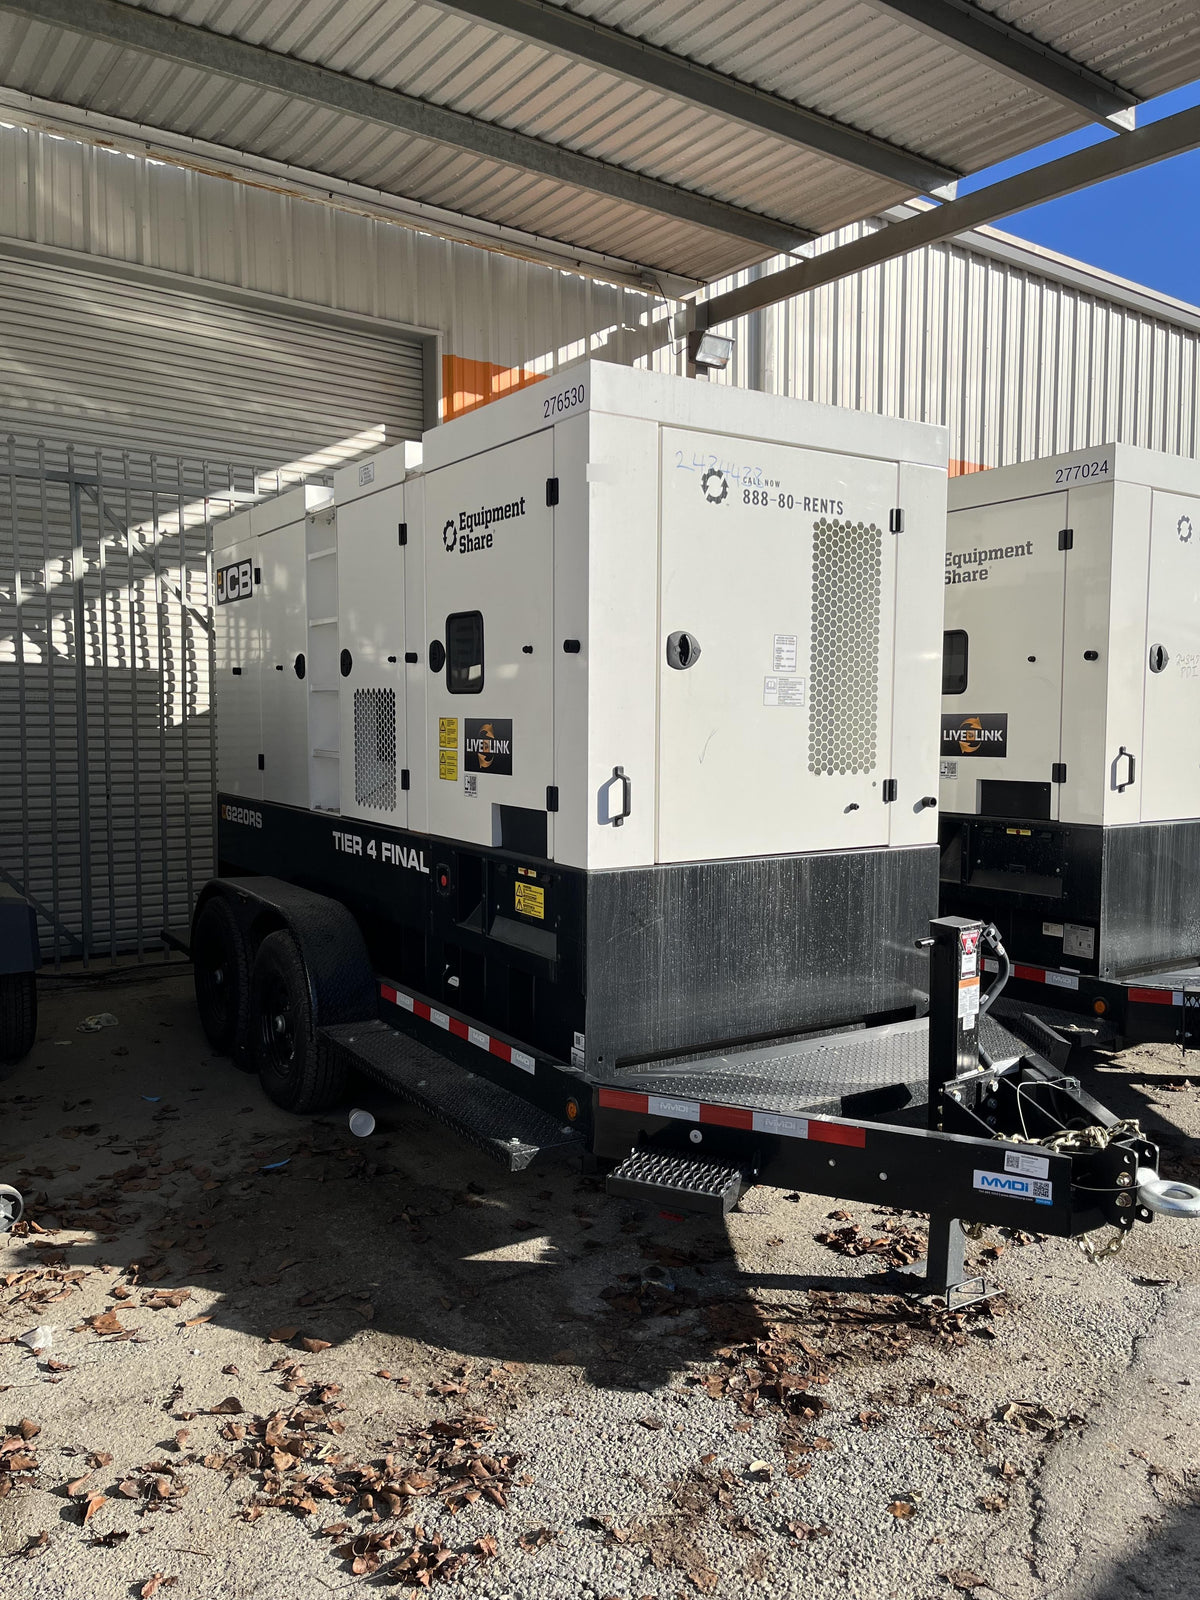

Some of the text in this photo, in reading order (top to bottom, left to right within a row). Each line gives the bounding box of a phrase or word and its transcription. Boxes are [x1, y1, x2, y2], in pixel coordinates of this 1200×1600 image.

[543, 384, 585, 418] 276530
[743, 476, 781, 488] CALL NOW
[1055, 459, 1109, 484] 277024
[458, 496, 526, 533] Equipment
[742, 488, 844, 516] 888-80-RENTS
[459, 533, 493, 554] Share
[945, 540, 1034, 569] Equipment
[217, 562, 252, 602] JCB
[944, 567, 989, 585] Share
[225, 804, 263, 829] G220RS
[332, 830, 430, 874] TIER 4 FINAL
